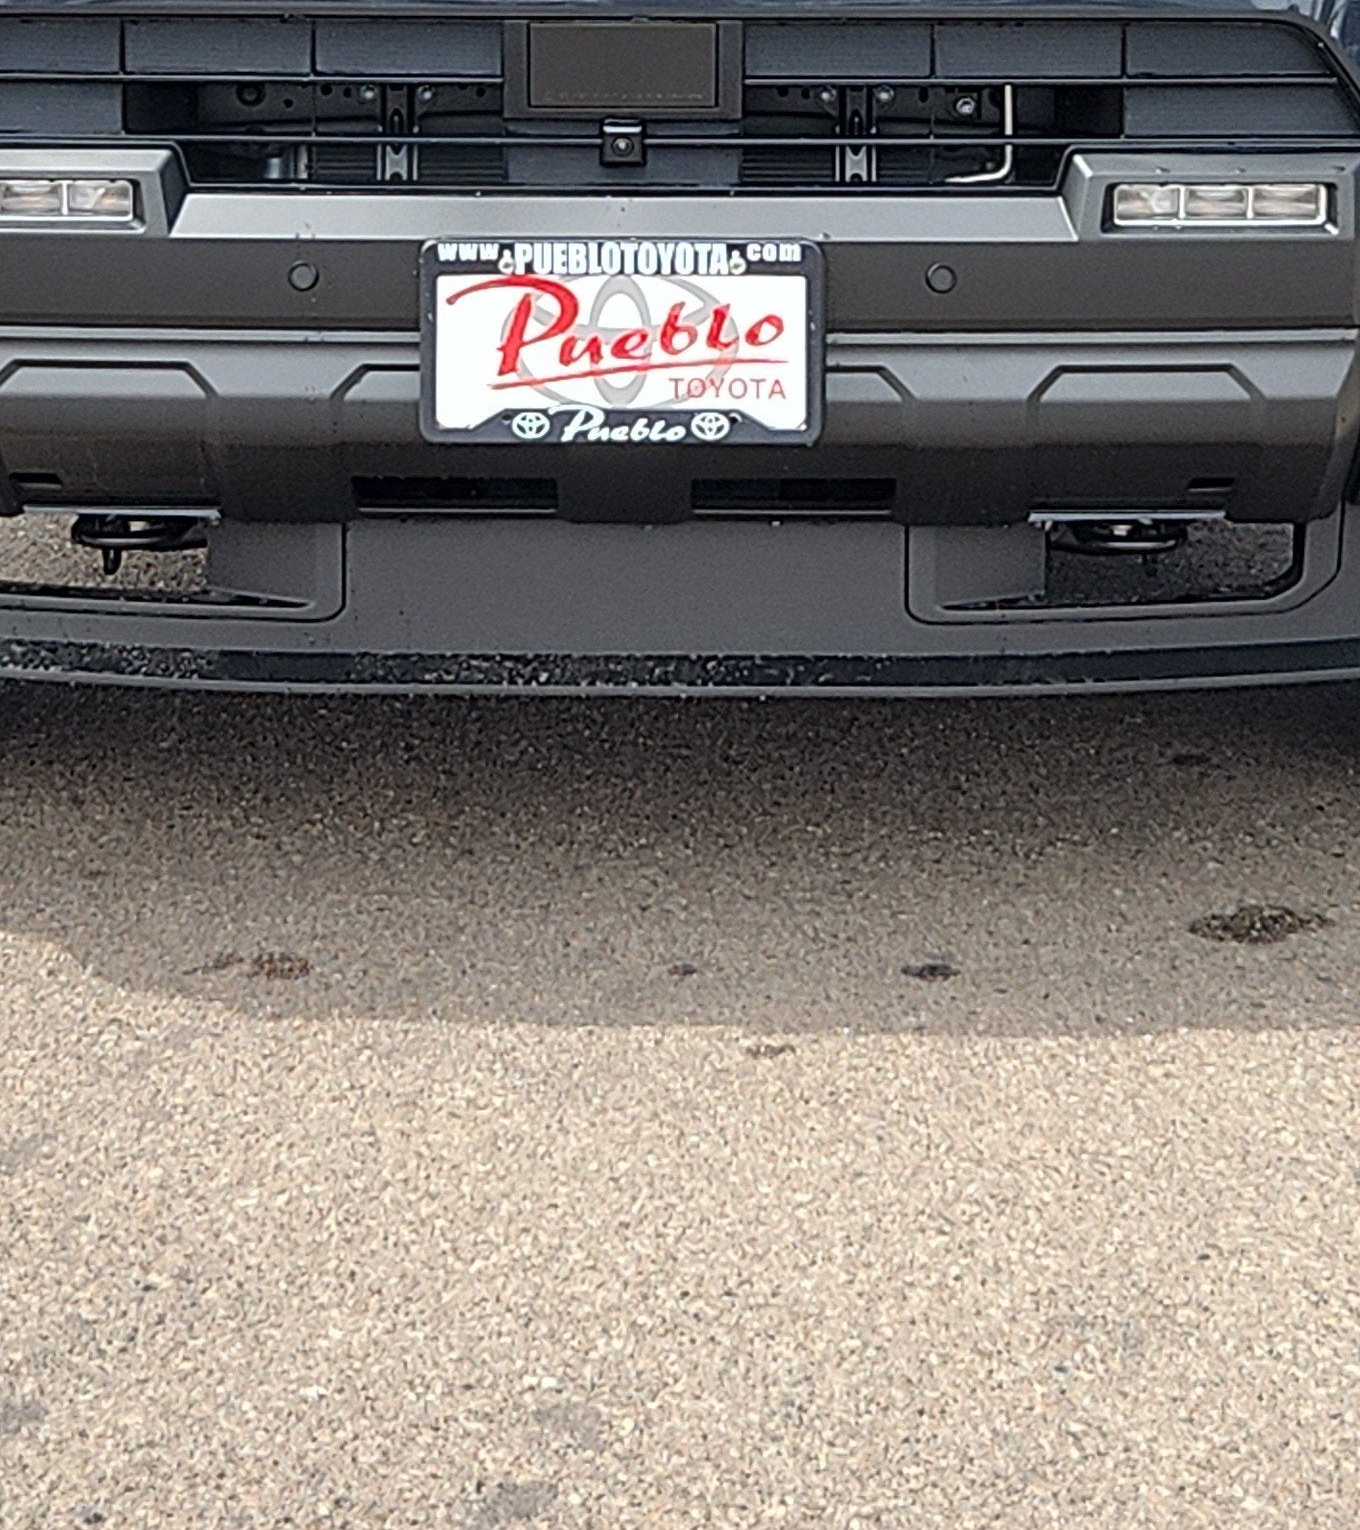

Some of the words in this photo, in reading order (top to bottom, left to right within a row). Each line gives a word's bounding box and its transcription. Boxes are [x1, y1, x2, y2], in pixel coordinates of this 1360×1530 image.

[446, 276, 785, 376] Pueblo
[669, 378, 786, 400] TOYOTA
[548, 404, 687, 442] Pueblo
